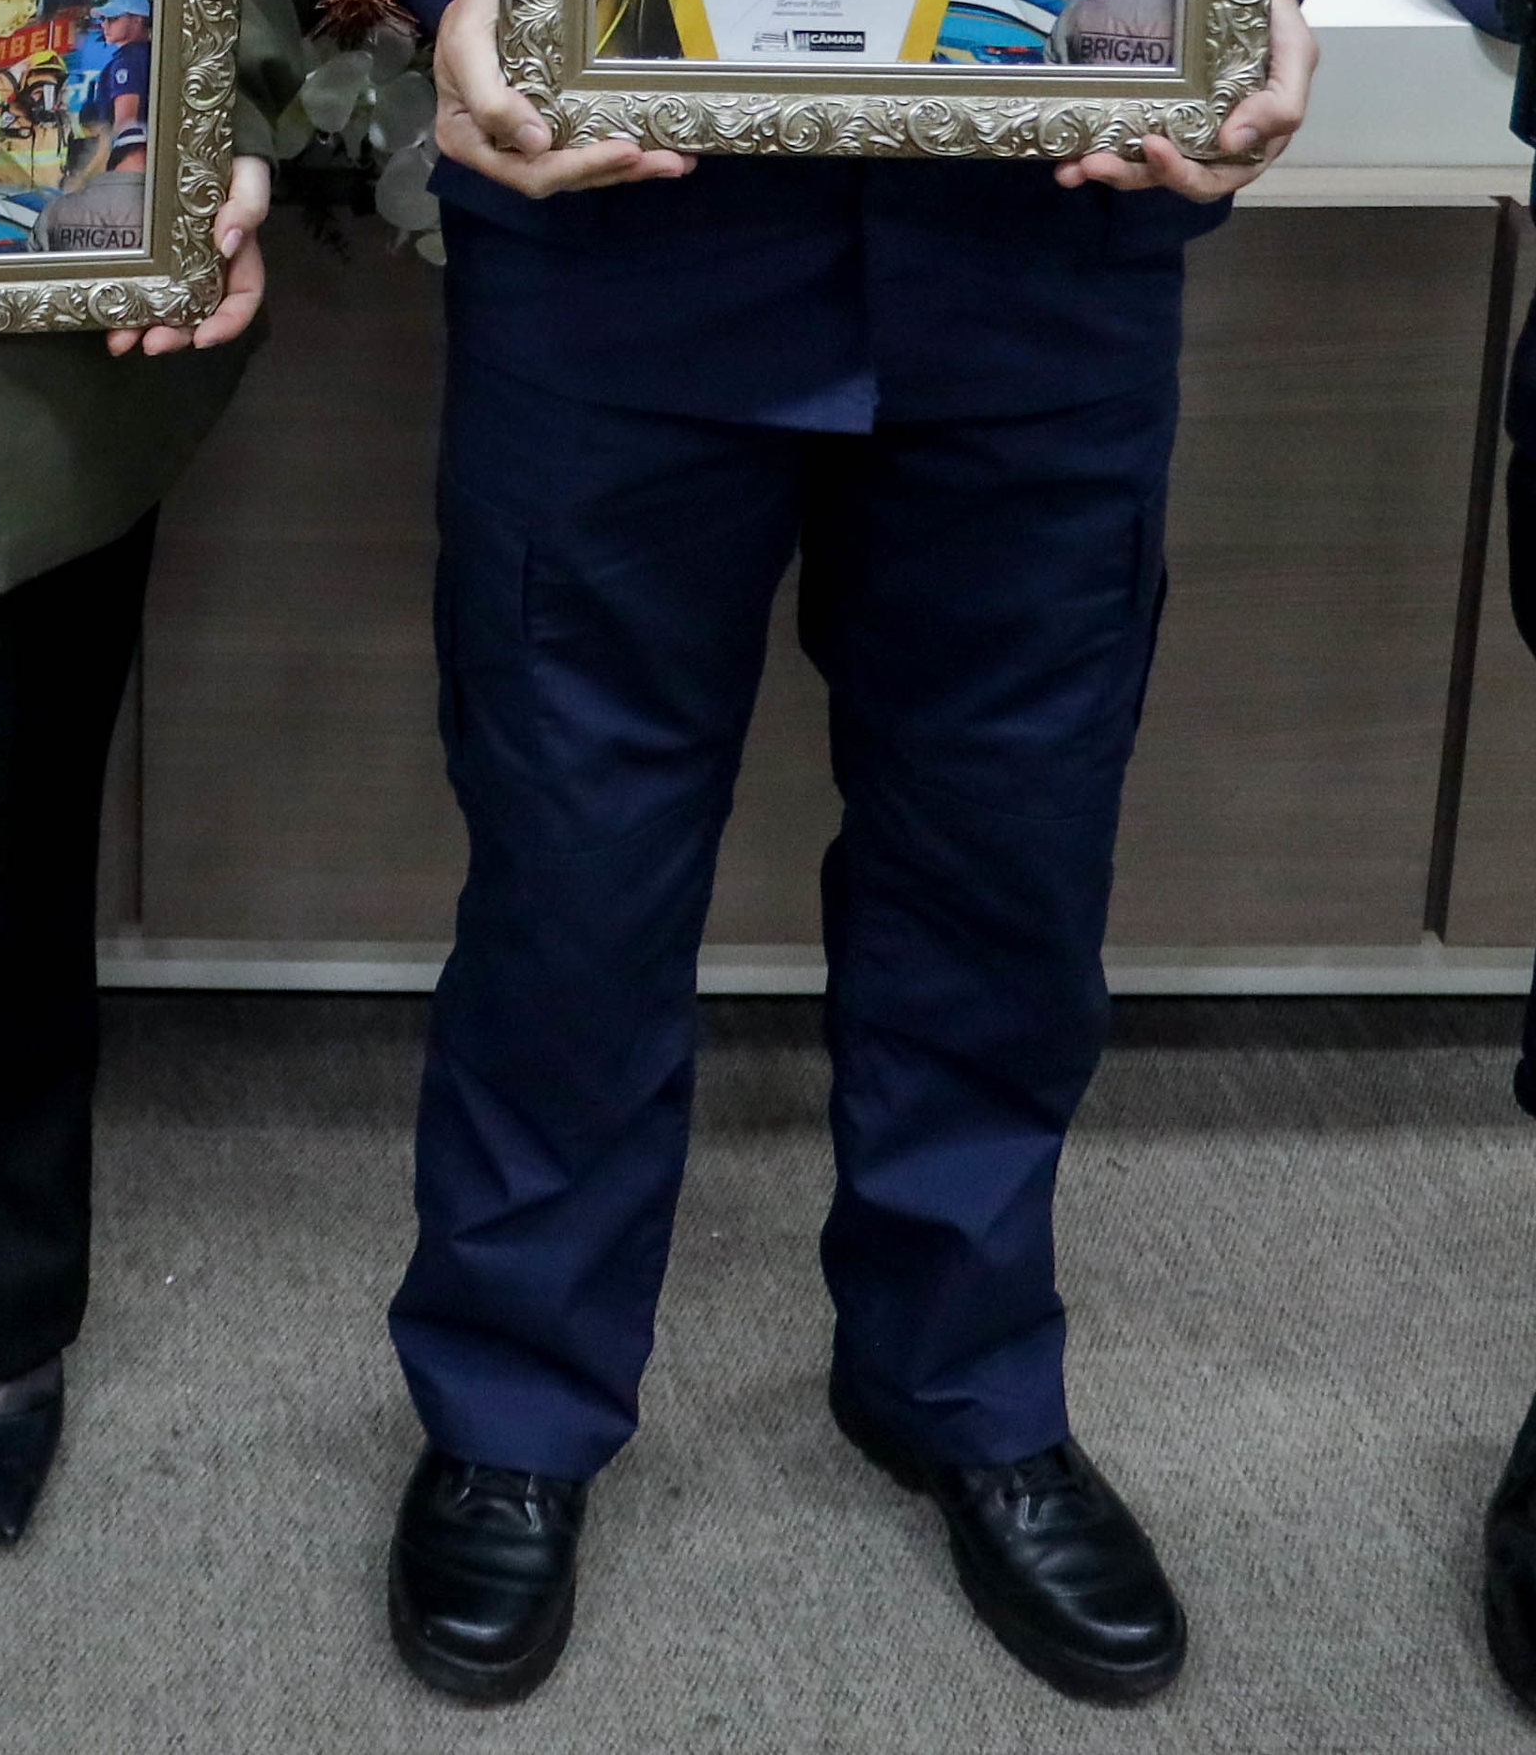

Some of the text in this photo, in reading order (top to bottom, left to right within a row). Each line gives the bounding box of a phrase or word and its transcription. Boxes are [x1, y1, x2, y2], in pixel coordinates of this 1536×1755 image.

[811, 33, 863, 44] CÂMARA
[1081, 37, 1172, 64] BRIGAD
[62, 228, 143, 250] BRIGAD
